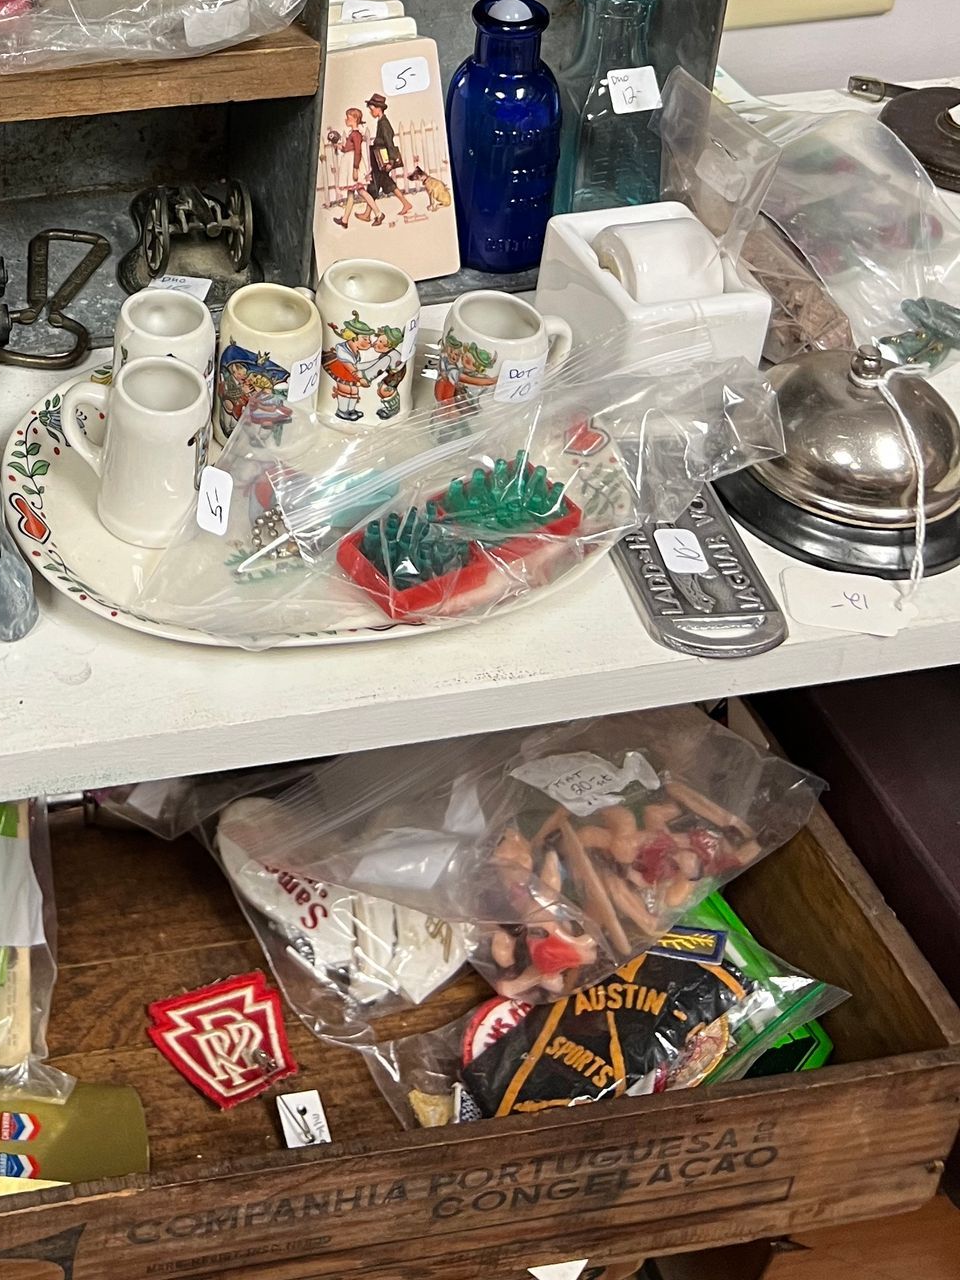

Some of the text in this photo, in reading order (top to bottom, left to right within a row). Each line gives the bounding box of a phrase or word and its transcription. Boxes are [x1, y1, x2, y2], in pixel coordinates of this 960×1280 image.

[509, 366, 539, 380] DOT
[705, 533, 767, 611] JAGUAR
[574, 982, 669, 1018] AUSTIN
[544, 1035, 615, 1089] SPORTS
[0, 1111, 11, 1141] CHEVRON
[125, 1127, 739, 1245] COMPANHIA PORTUGUESA
